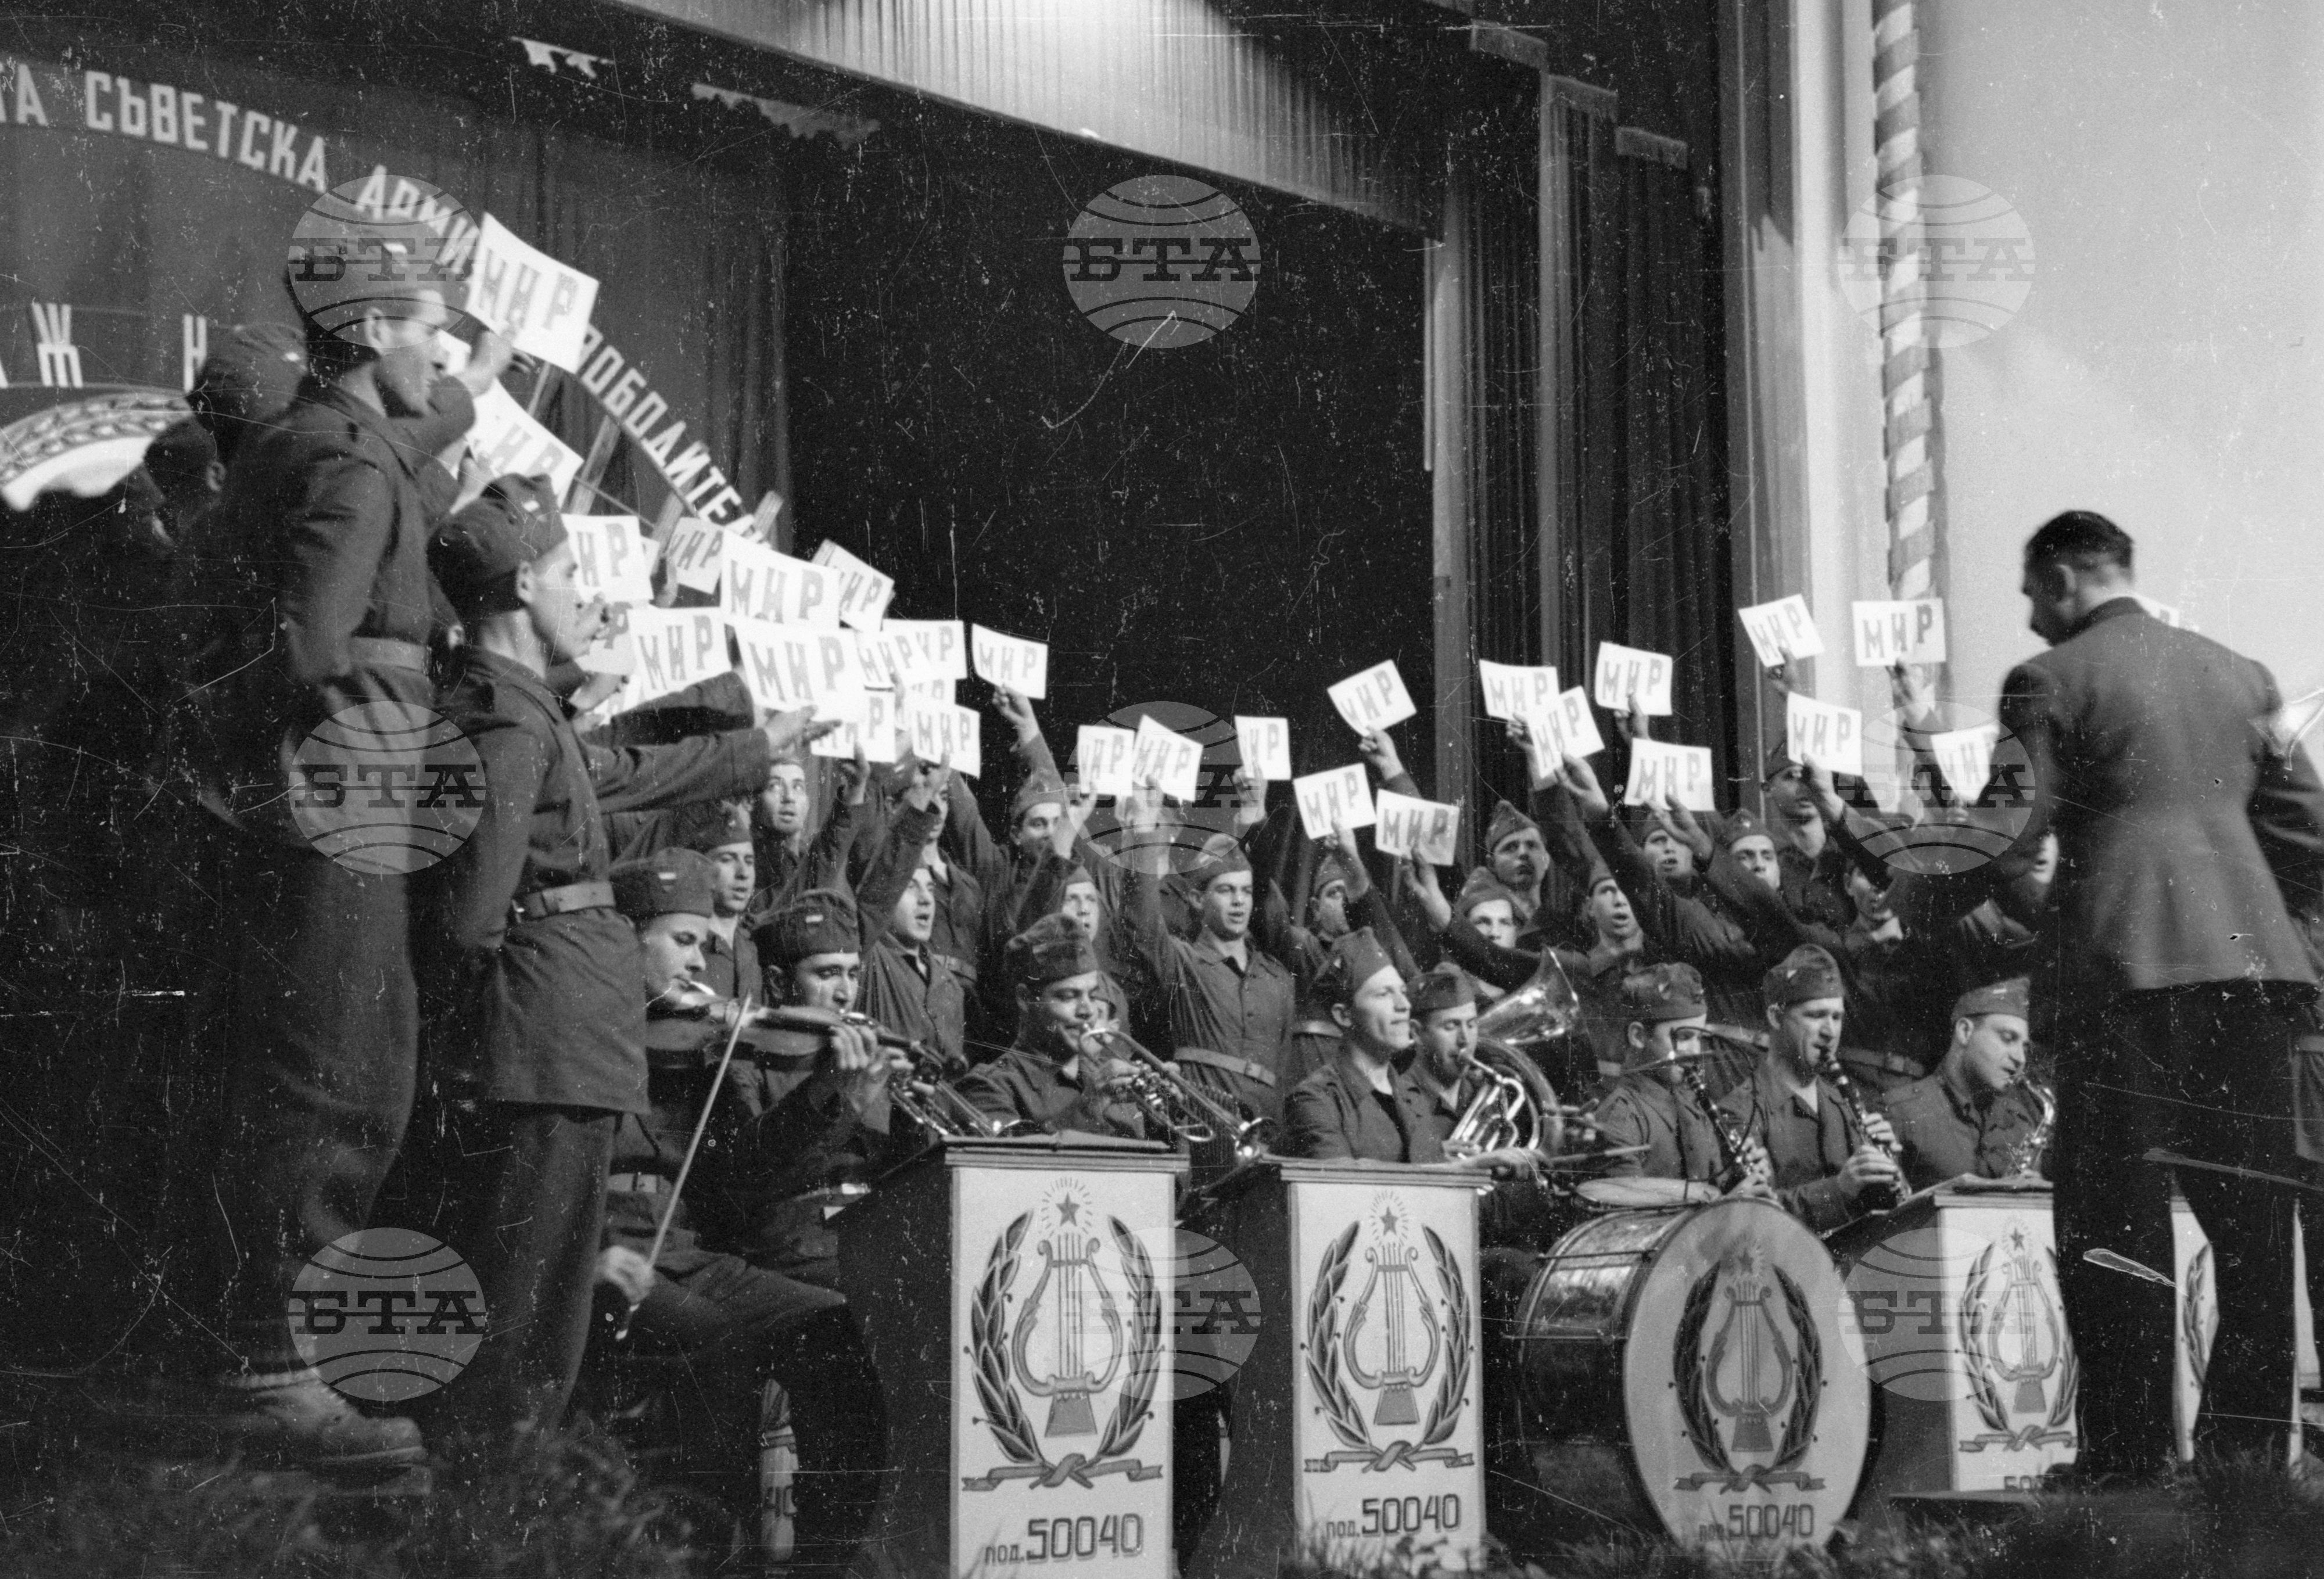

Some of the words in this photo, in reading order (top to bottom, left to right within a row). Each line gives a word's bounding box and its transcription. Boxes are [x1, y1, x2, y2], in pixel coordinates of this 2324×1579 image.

[0, 62, 48, 126] А
[85, 70, 327, 193] СЪВЕТСКА
[356, 164, 480, 275] АРМИ
[478, 249, 579, 331] МИР
[475, 417, 565, 475] ИР
[576, 523, 629, 587] ИР
[730, 558, 824, 625] МИР
[840, 571, 883, 612] ИР
[638, 614, 713, 690] МИР
[914, 625, 955, 662] ИР
[1751, 602, 1803, 660] МИР
[1862, 604, 1934, 659] МИР
[747, 636, 845, 702] МИР
[978, 642, 1037, 681] МИР
[1602, 658, 1663, 702] МИР
[1489, 671, 1548, 713] МИР
[916, 710, 971, 755] МИР
[1534, 696, 1580, 769] МИР
[1792, 712, 1852, 756] МИР
[1303, 770, 1359, 832] МИР
[1633, 752, 1701, 801] МИР
[1382, 808, 1449, 849] МИР
